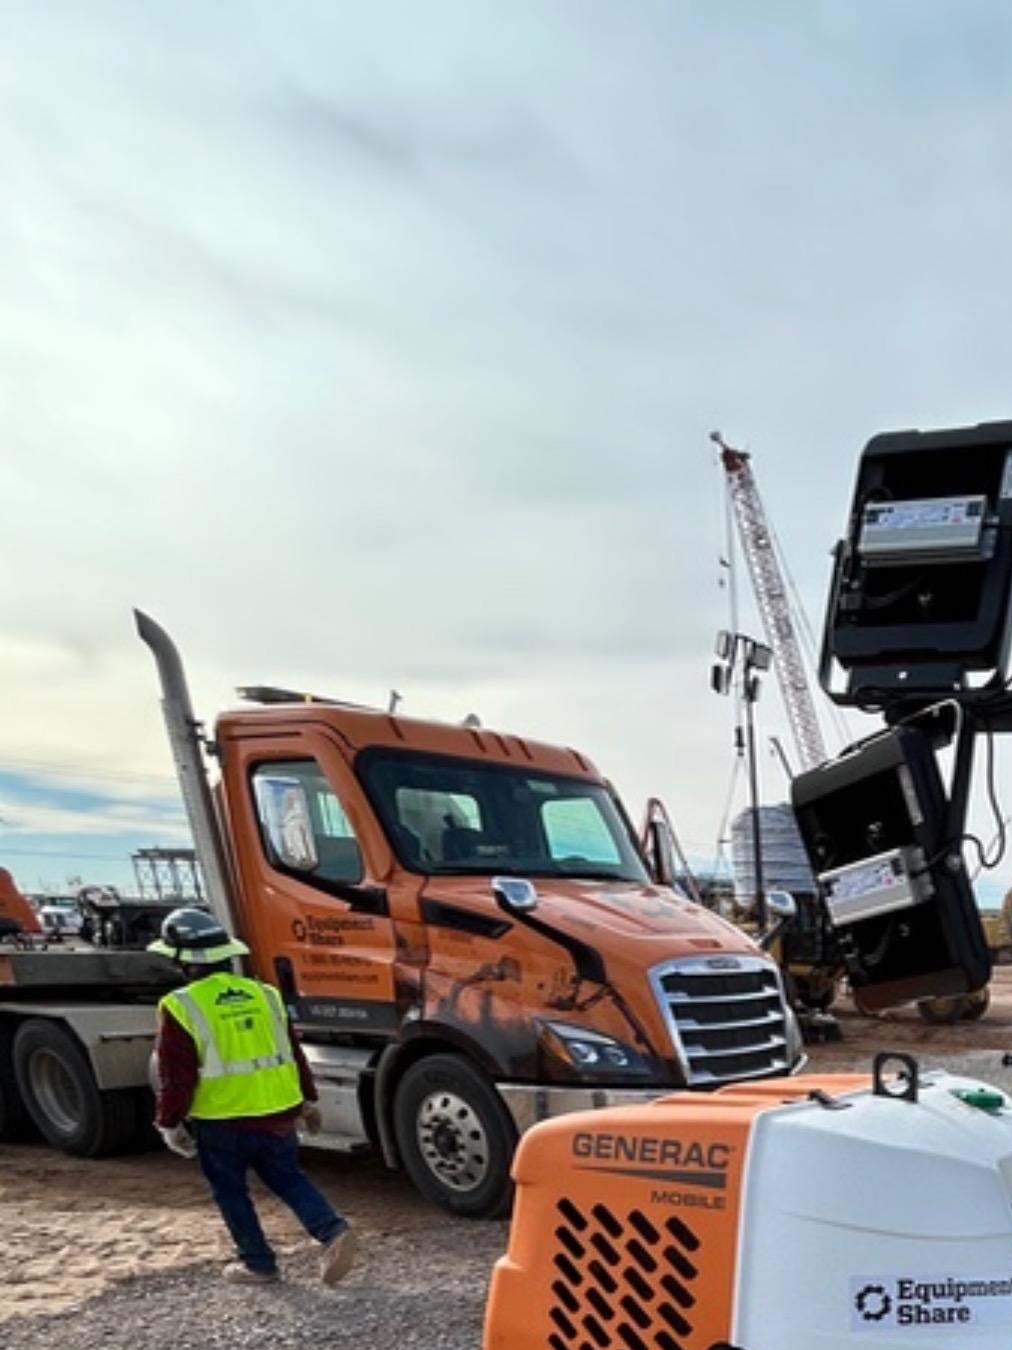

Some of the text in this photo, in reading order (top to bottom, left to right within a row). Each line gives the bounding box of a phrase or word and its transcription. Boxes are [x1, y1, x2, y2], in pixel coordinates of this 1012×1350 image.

[573, 1133, 729, 1168] GENERAC
[651, 1190, 726, 1209] MOBILE
[897, 1303, 971, 1325] Share
